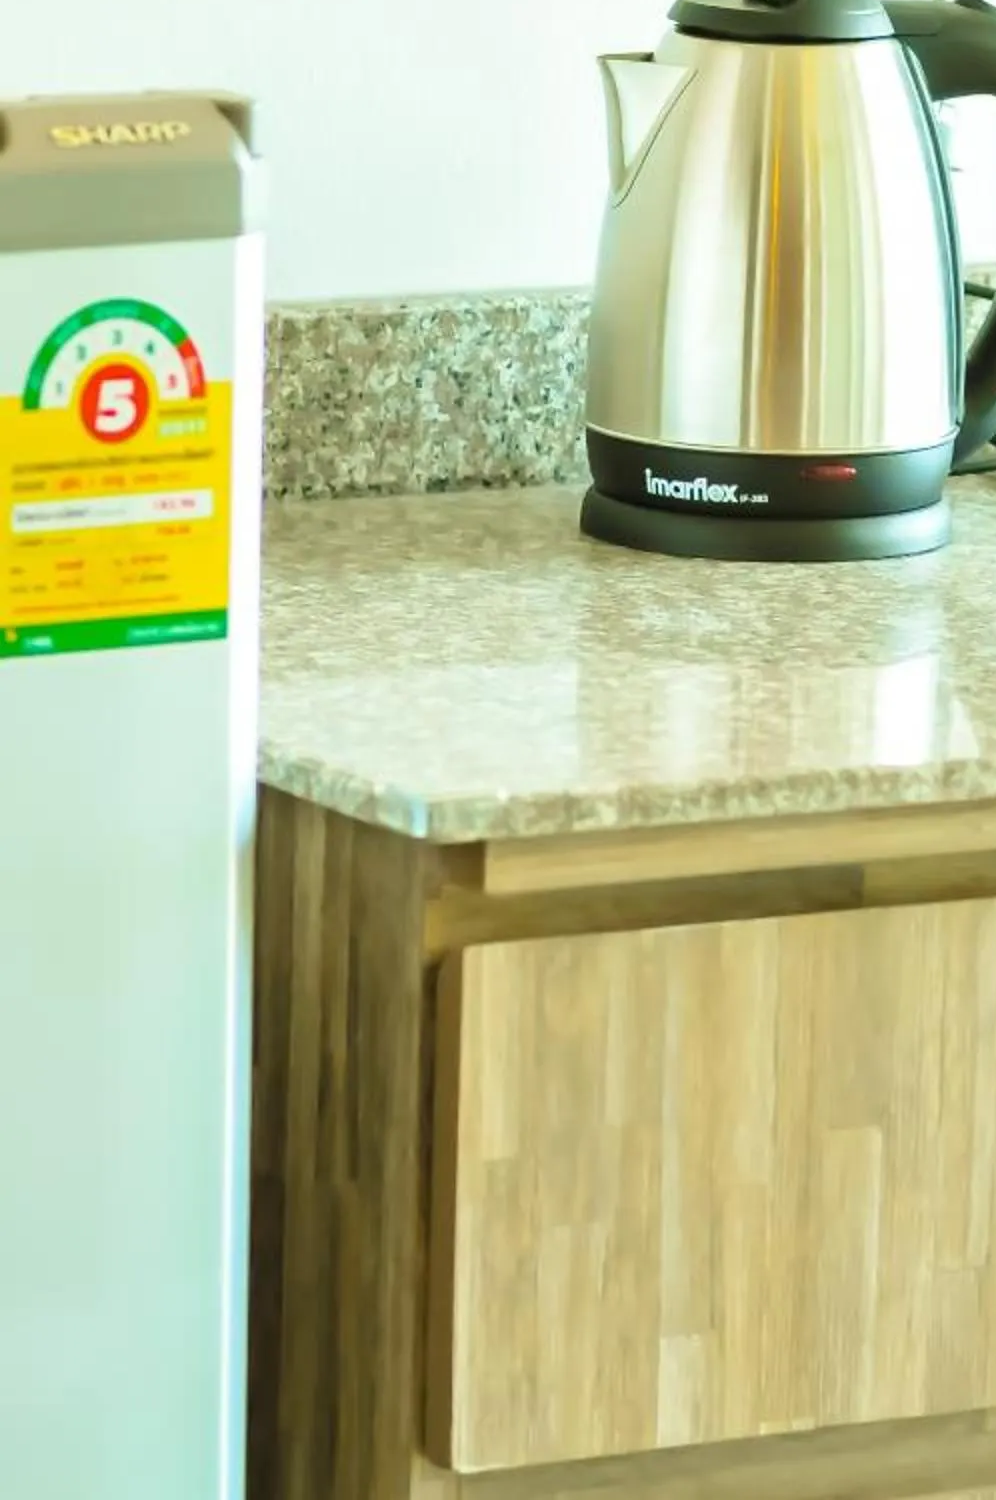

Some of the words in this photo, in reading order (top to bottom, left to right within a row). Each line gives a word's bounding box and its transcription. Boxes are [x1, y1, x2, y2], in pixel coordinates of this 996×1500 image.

[49, 120, 192, 149] SHARP
[95, 378, 136, 433] 5
[645, 467, 740, 504] imarflex
